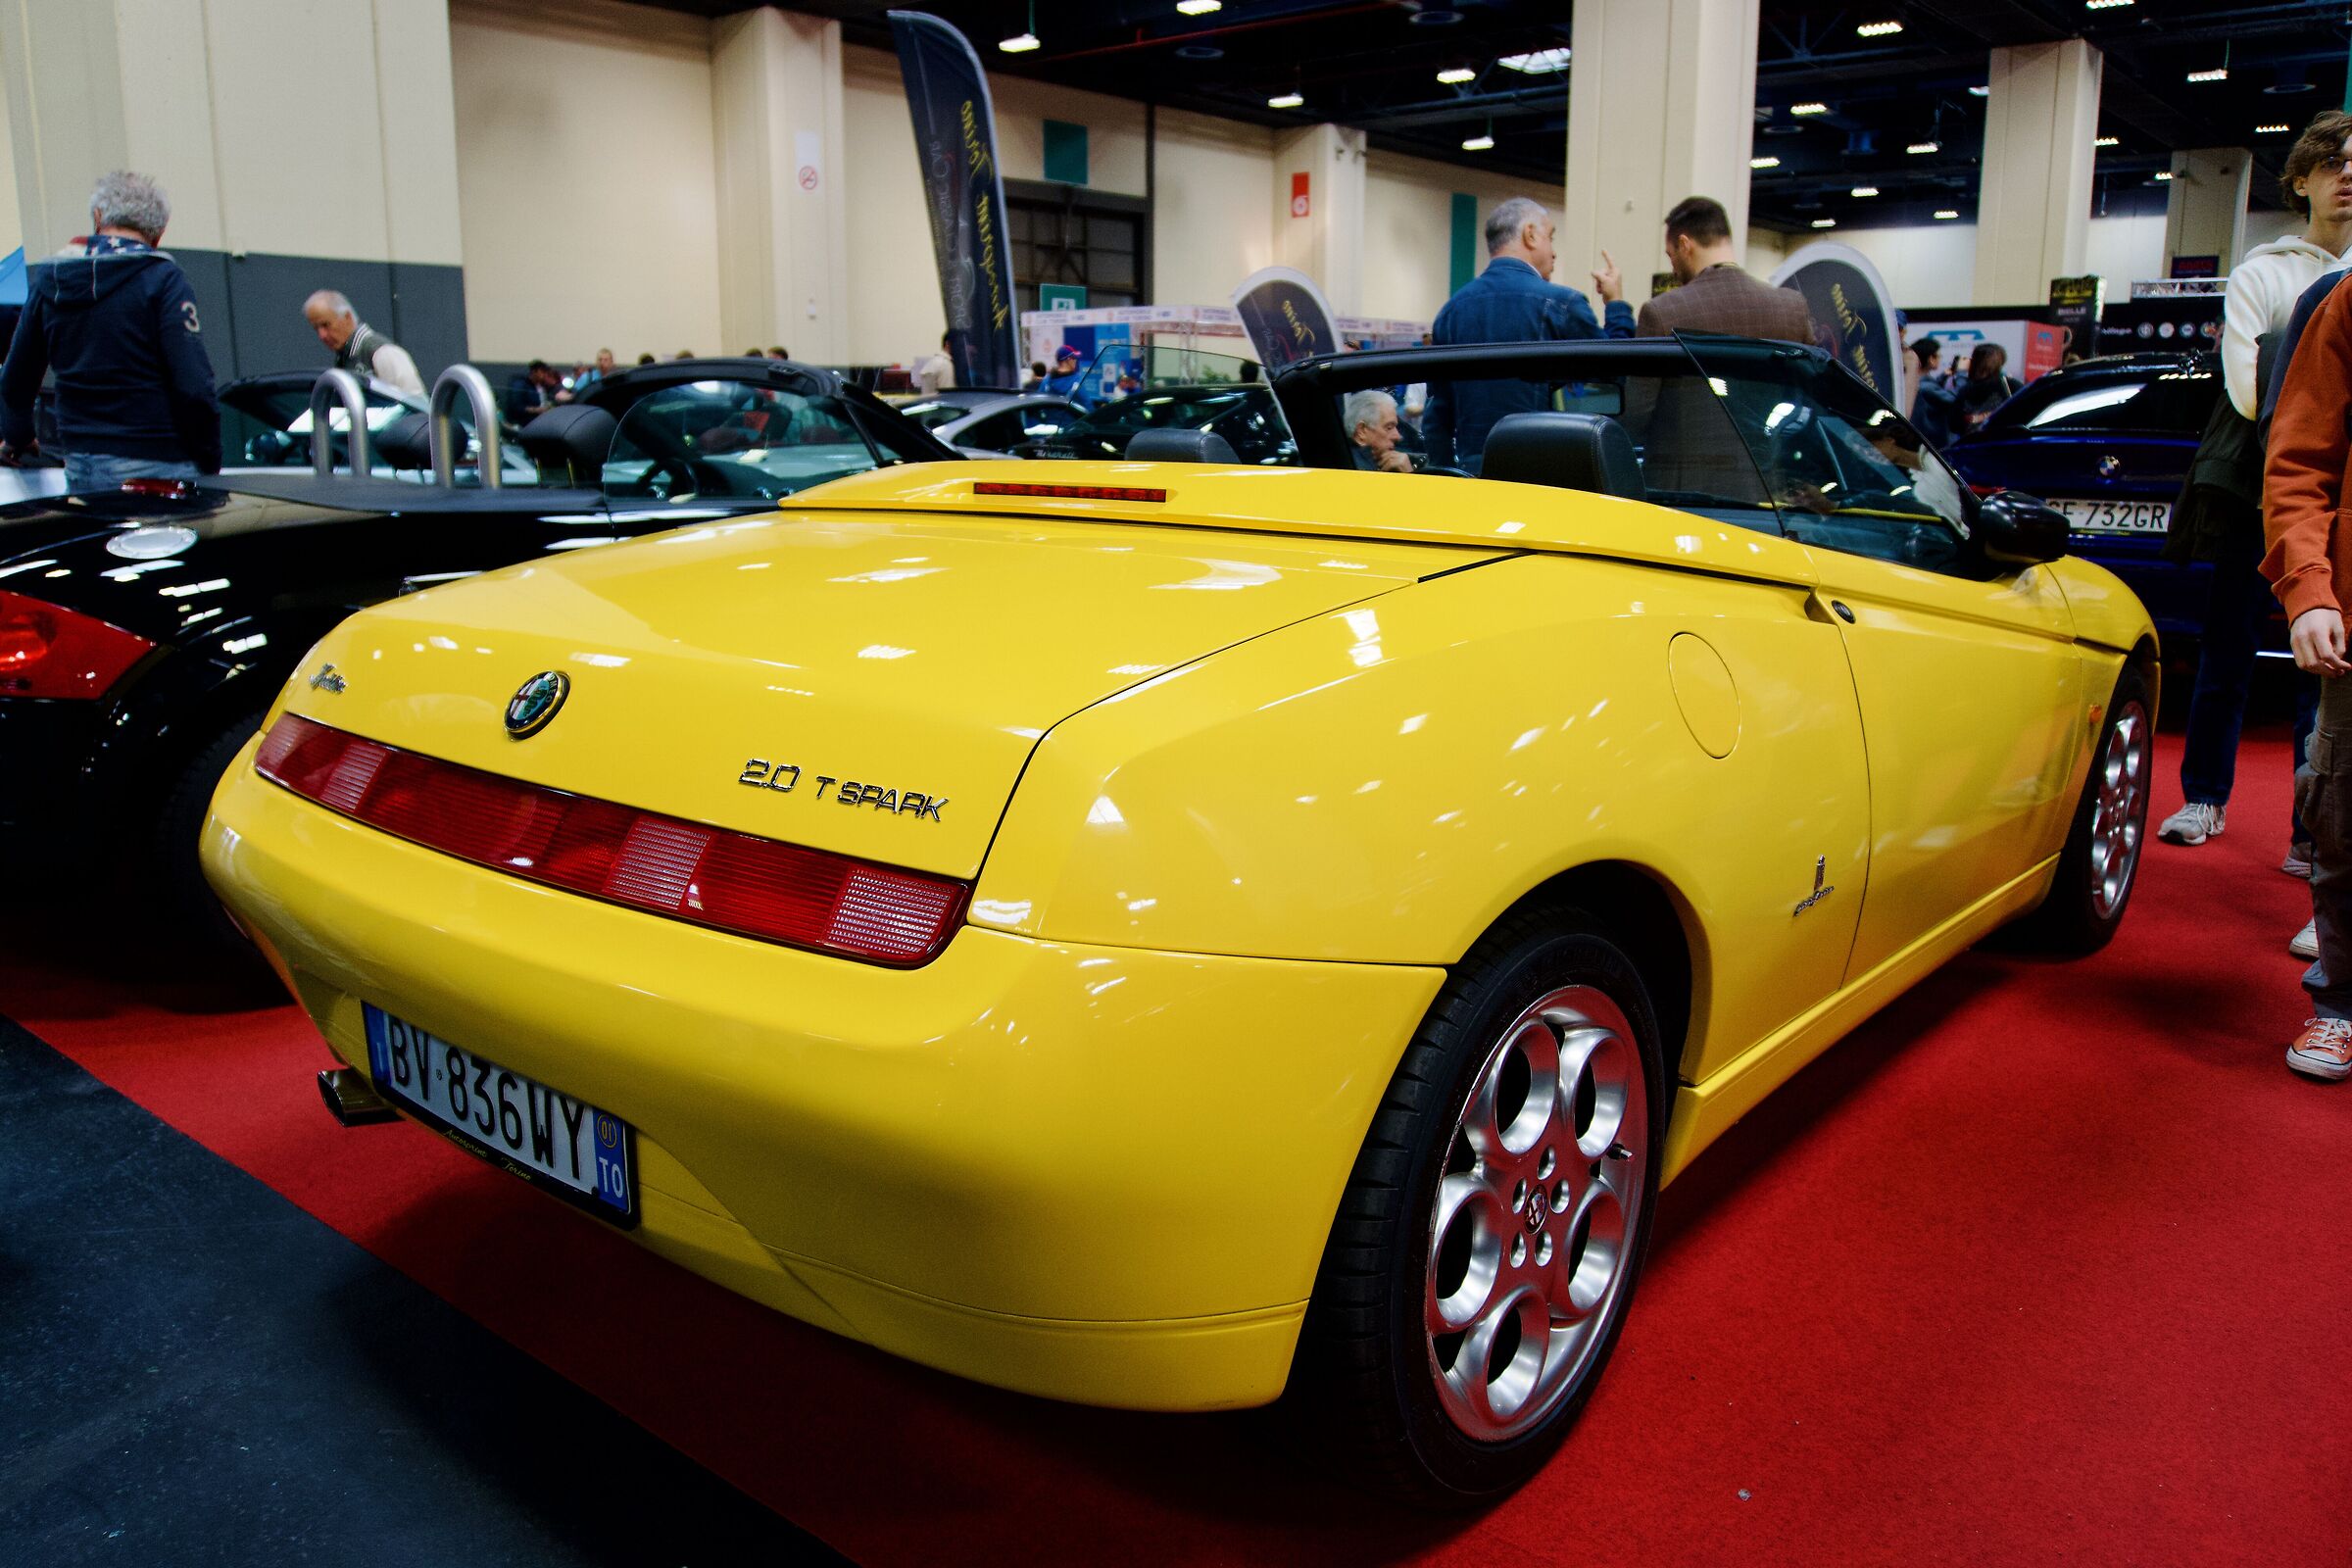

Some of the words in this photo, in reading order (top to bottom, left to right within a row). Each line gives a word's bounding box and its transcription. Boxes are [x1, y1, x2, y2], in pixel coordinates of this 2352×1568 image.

[180, 301, 200, 332] 3
[2084, 503, 2167, 529] 732GR
[501, 1156, 531, 1180] Torino
[599, 1156, 624, 1199] TO
